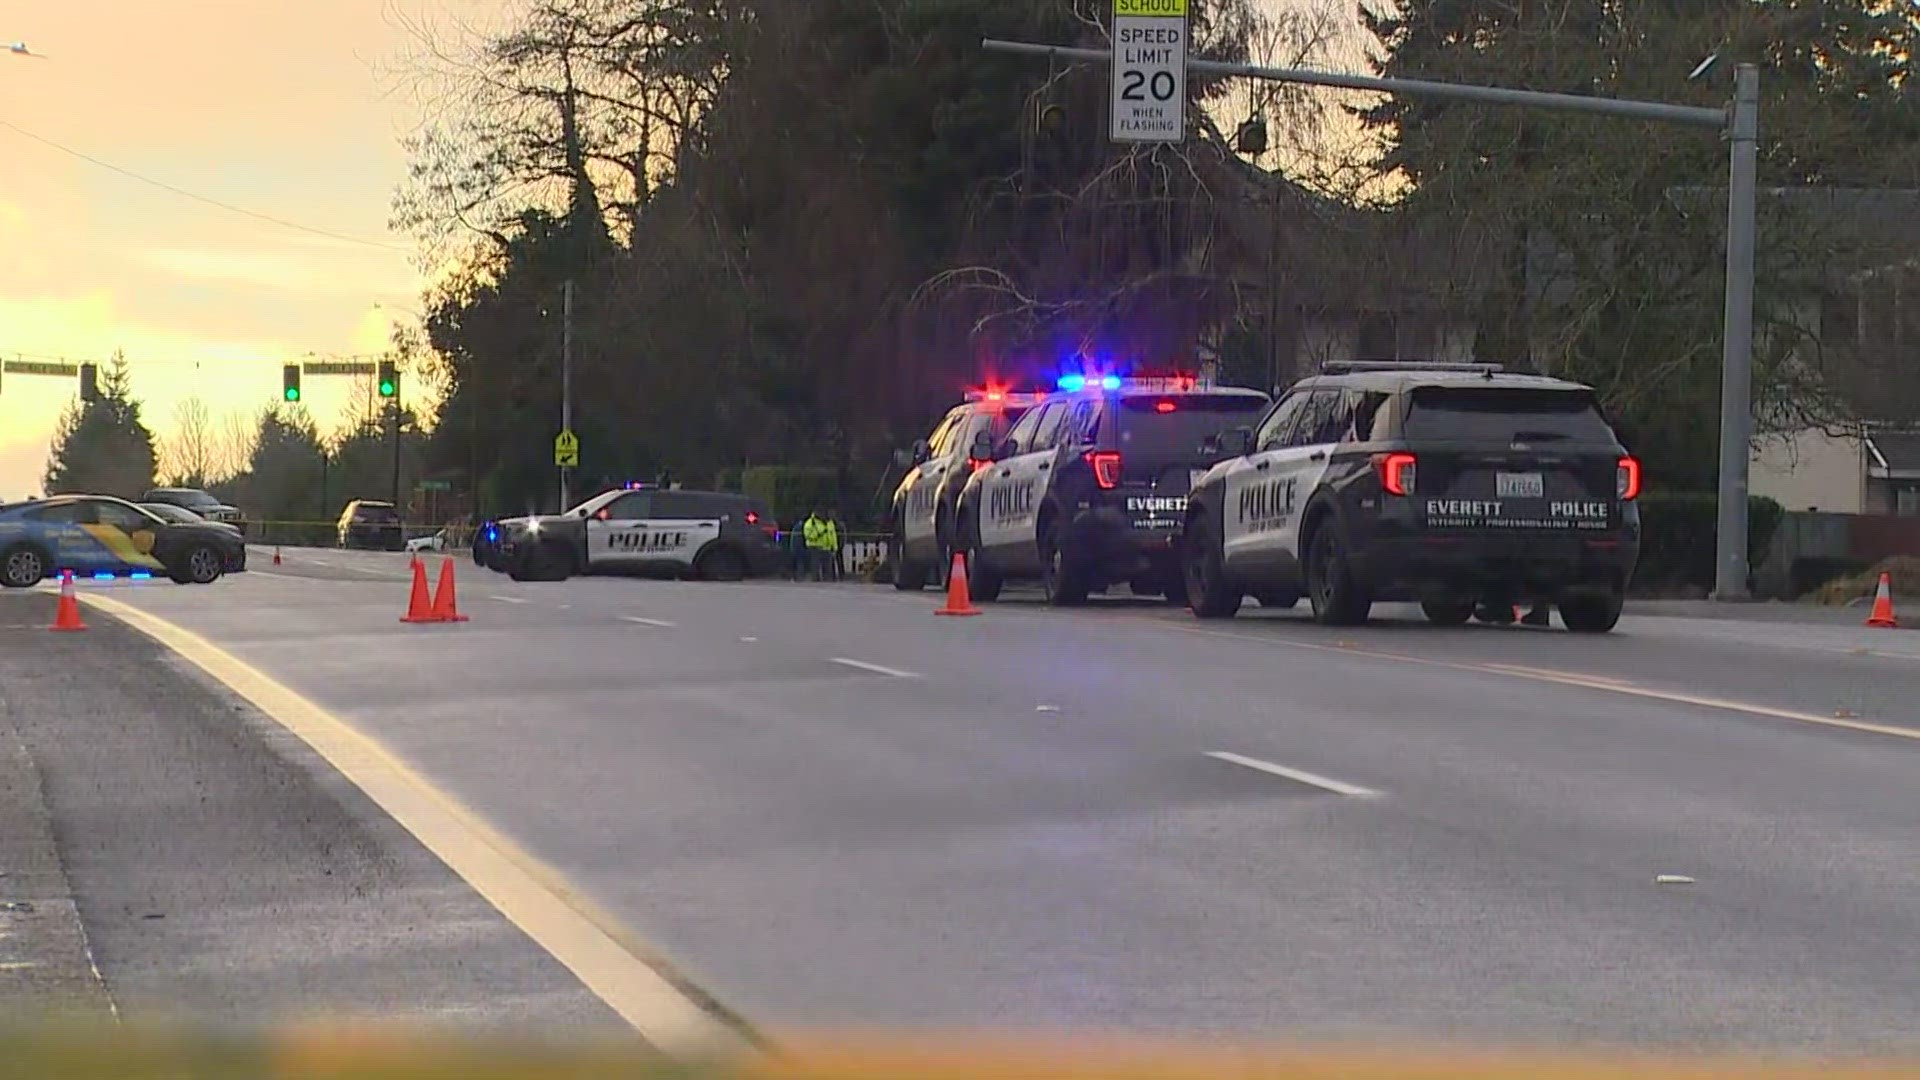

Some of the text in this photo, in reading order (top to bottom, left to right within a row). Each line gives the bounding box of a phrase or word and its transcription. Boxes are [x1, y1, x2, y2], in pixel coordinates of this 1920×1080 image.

[1120, 0, 1181, 12] SCHOOL
[1120, 29, 1179, 43] SPEED
[1125, 49, 1172, 63] LIMIT
[1122, 70, 1175, 101] 20
[1132, 108, 1163, 118] WHEN
[1120, 121, 1174, 132] FLASHING
[991, 479, 1033, 519] POLICE
[1239, 476, 1297, 524] POLICE
[1427, 500, 1608, 517] EVERETT POLICE
[608, 532, 687, 548] POLICE
